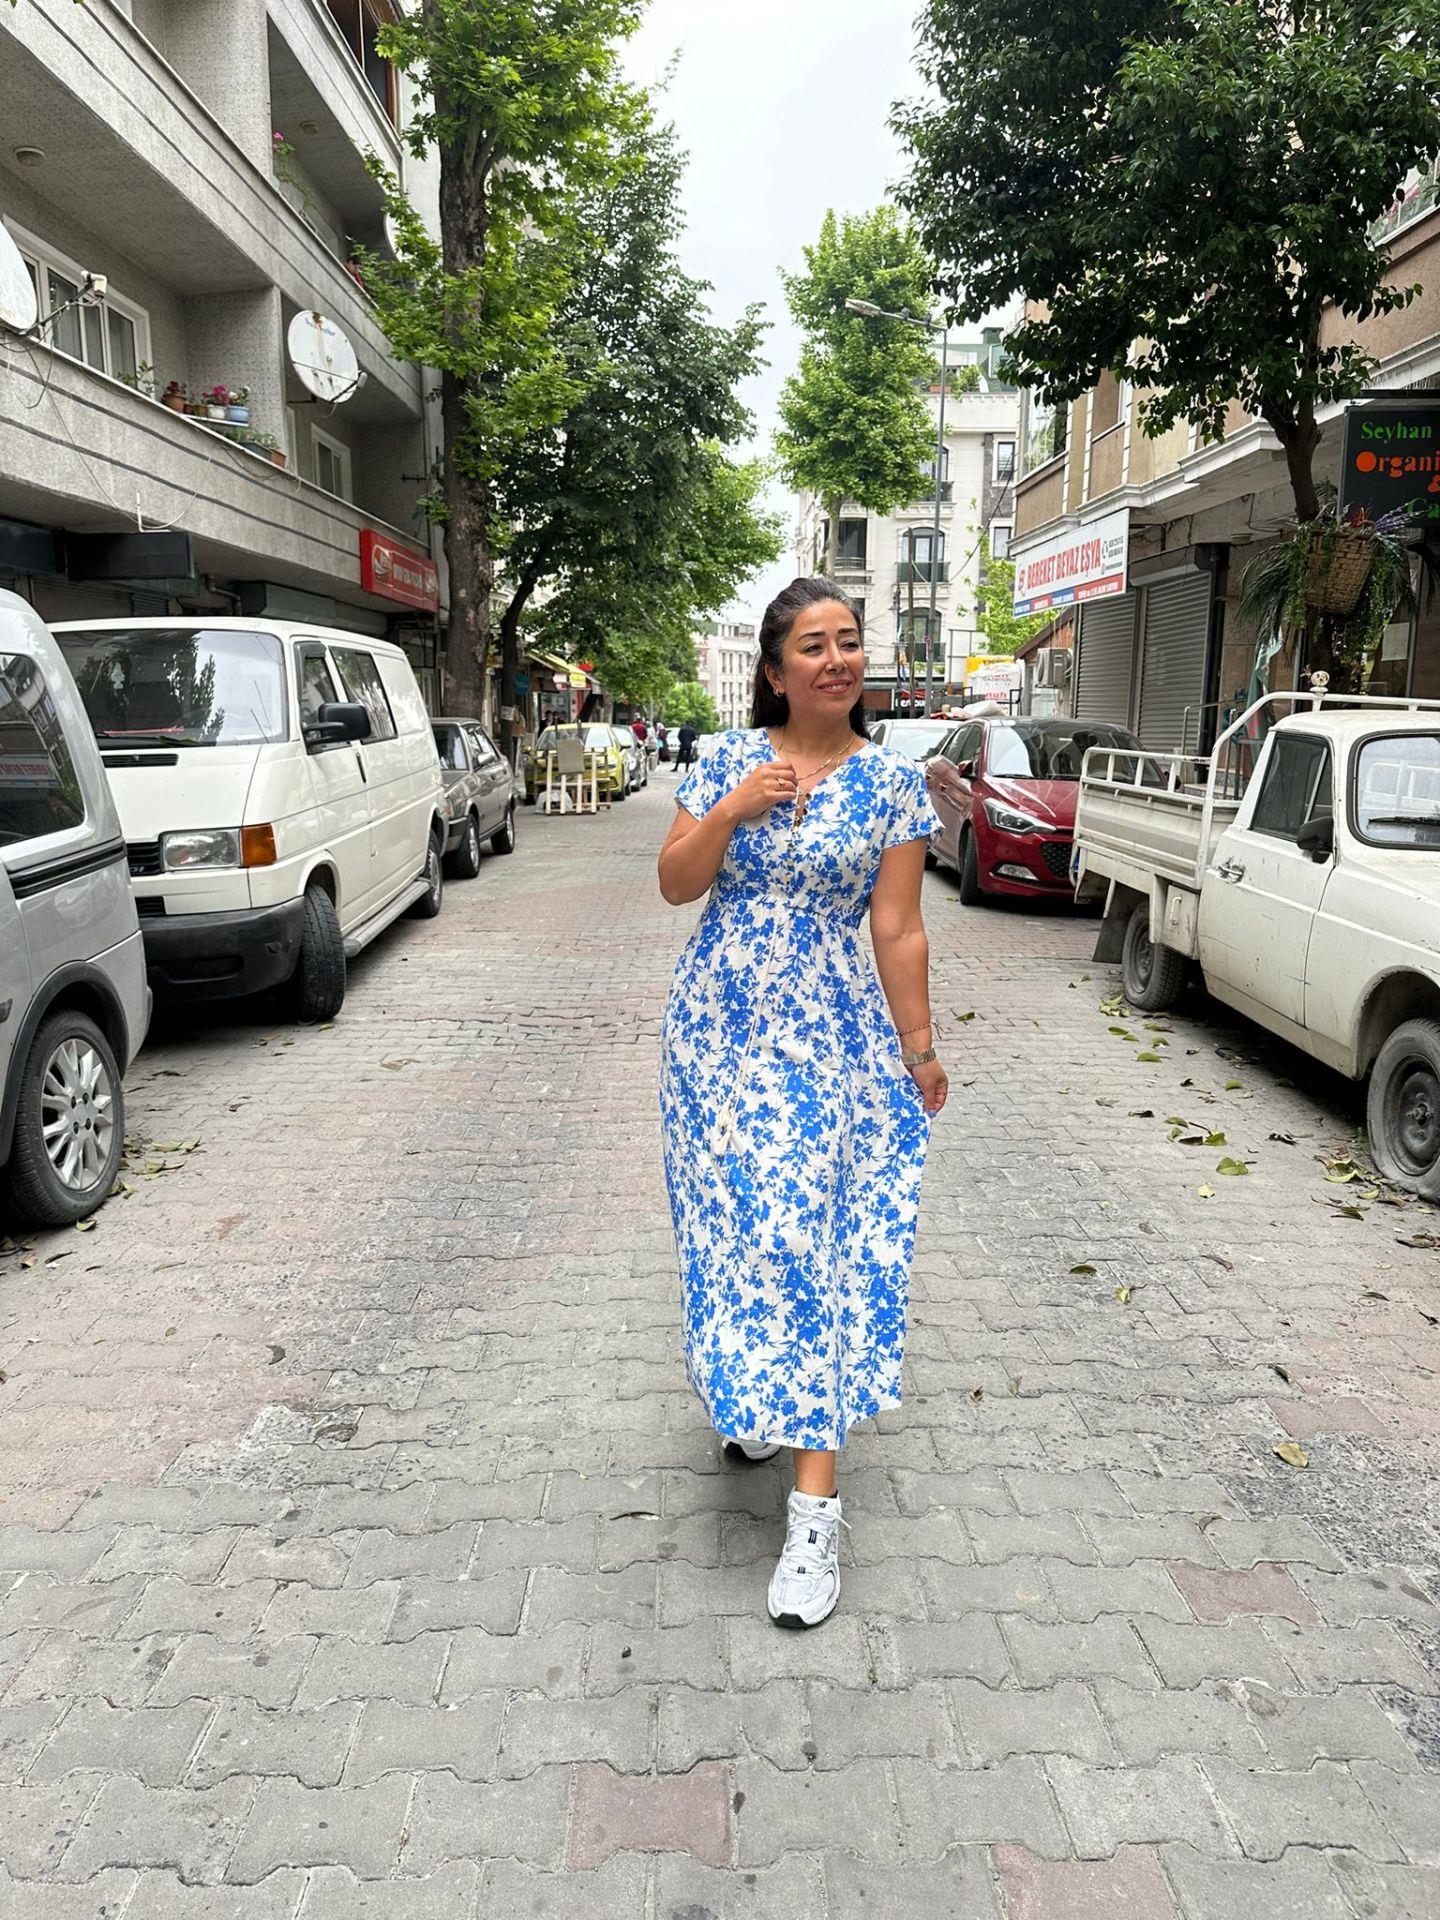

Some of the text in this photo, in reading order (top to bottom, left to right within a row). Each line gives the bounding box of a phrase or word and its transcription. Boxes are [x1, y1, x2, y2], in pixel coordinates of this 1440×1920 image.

[1361, 421, 1432, 443] Seyhan
[1027, 555, 1056, 590] BEREKET
[1056, 546, 1080, 580] BEYAZ
